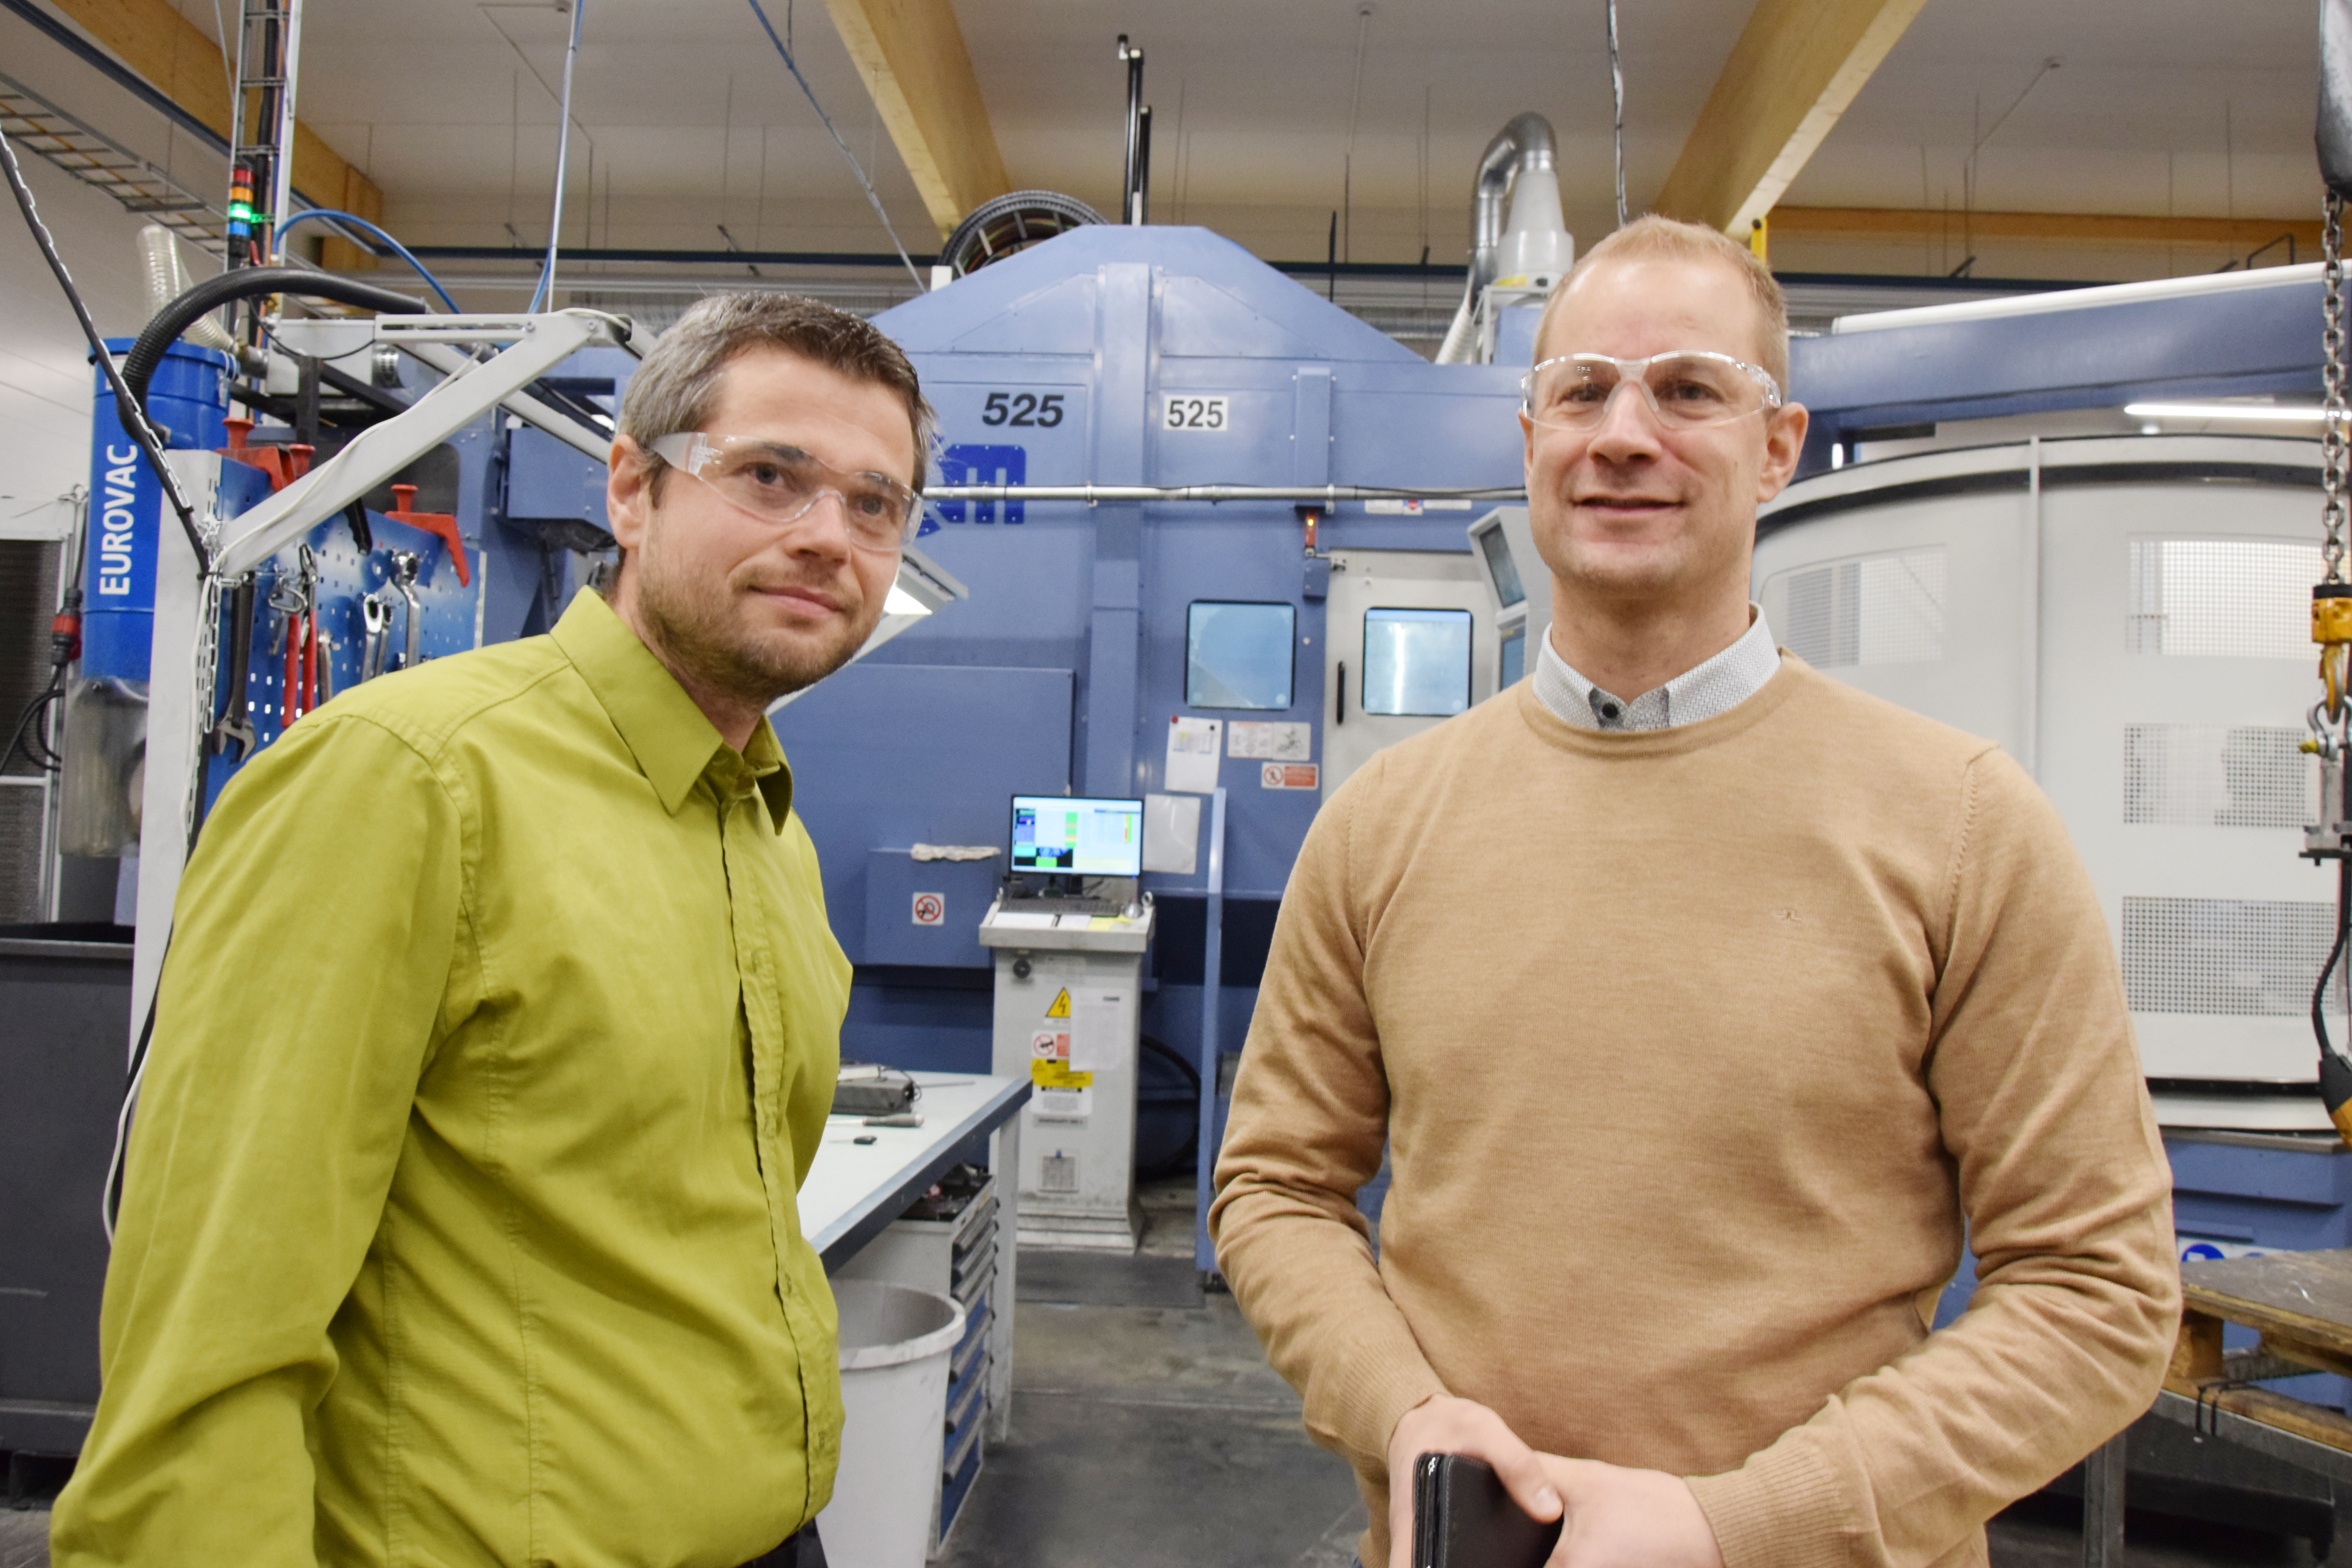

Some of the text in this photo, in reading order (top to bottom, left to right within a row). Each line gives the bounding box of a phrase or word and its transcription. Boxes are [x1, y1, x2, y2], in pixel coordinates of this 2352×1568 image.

[982, 393, 1064, 427] 525
[1169, 400, 1222, 428] 525
[99, 445, 137, 595] EUROVAC
